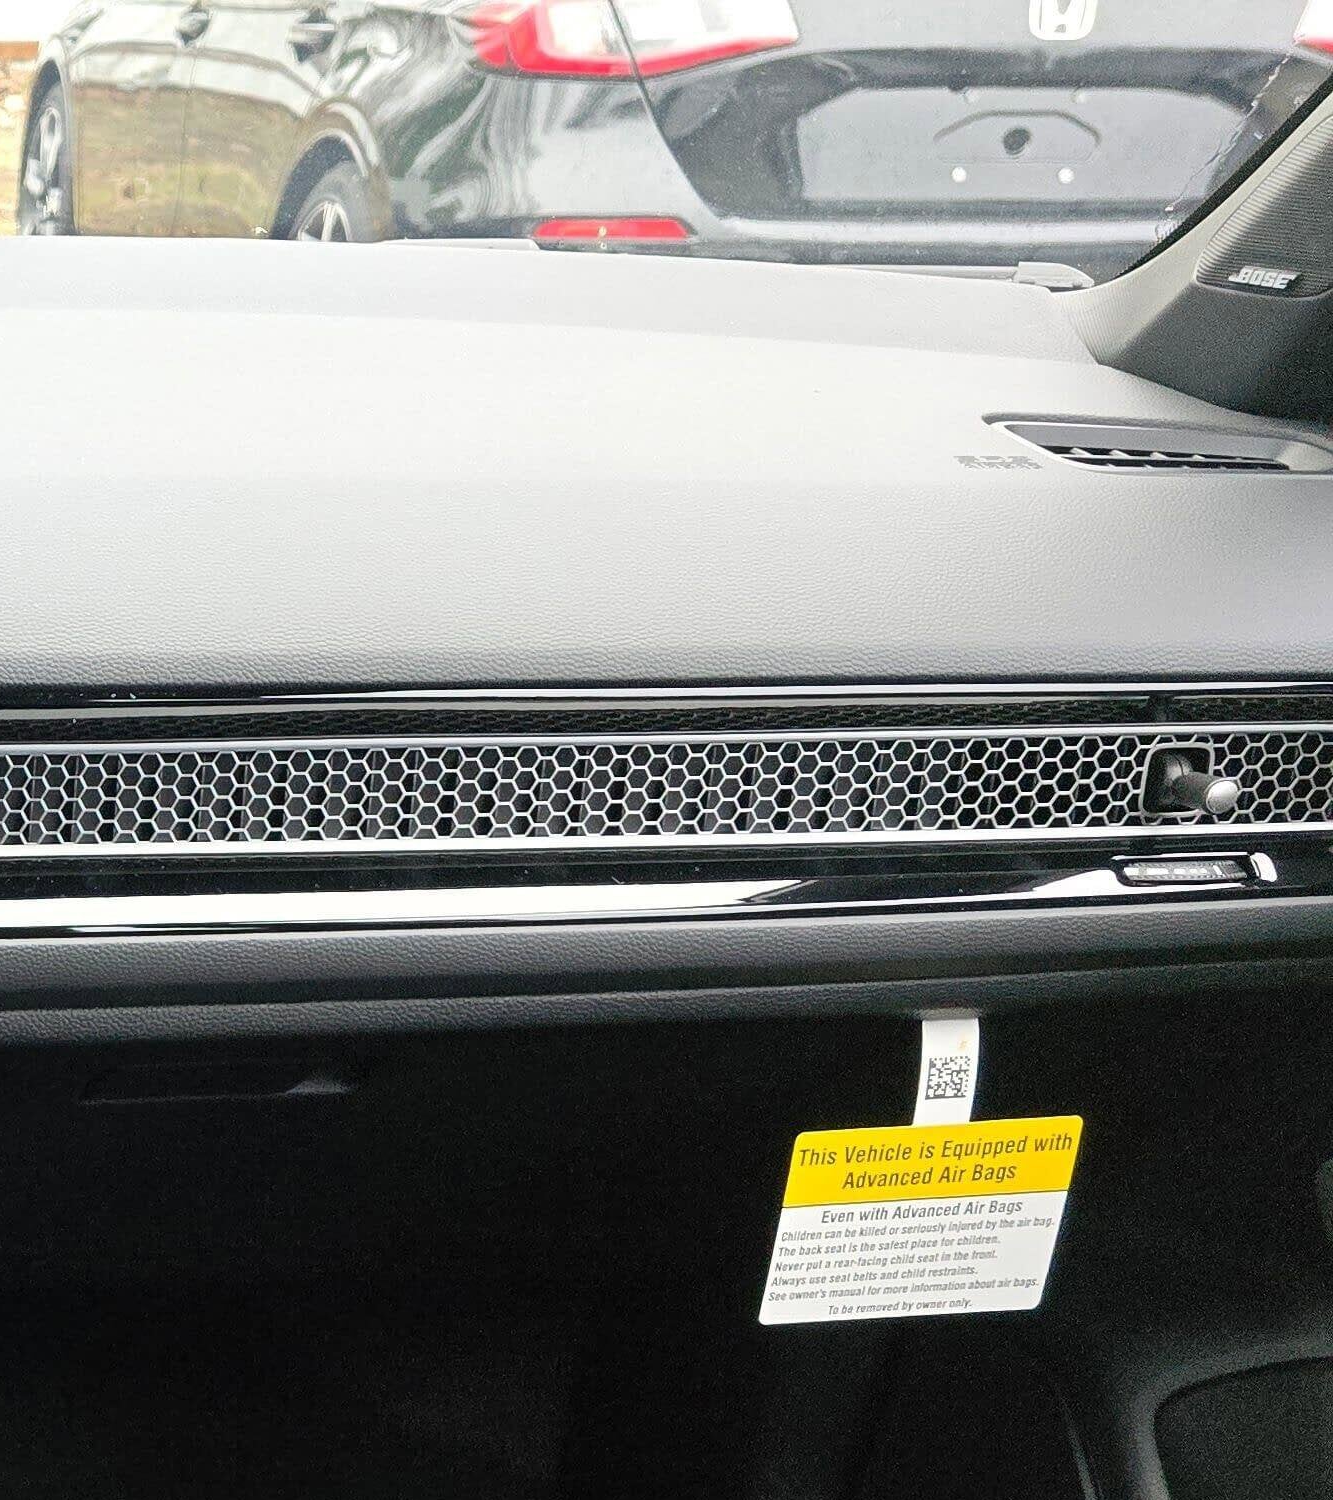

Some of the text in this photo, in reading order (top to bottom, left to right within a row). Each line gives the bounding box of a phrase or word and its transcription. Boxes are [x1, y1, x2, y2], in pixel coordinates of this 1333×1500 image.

[1228, 266, 1301, 289] BOSE
[798, 1132, 1072, 1167] This Vehicle is Equipped with
[842, 1163, 1017, 1189] Advanced Air Bags
[821, 1200, 1023, 1224] Even with Advanced Air Bags
[781, 1216, 1055, 1242] Children can be killed or seriously injured by the air bag.
[778, 1235, 1001, 1257] The back seat is the safest place for children.
[775, 1249, 998, 1272] Never put a rear-facing child seat in the front.
[771, 1266, 978, 1288] Always use seat belts and child restraints.
[768, 1277, 1039, 1302] See owner's manual for more information about air bags.
[828, 1298, 972, 1315] To be removed by owner only.
